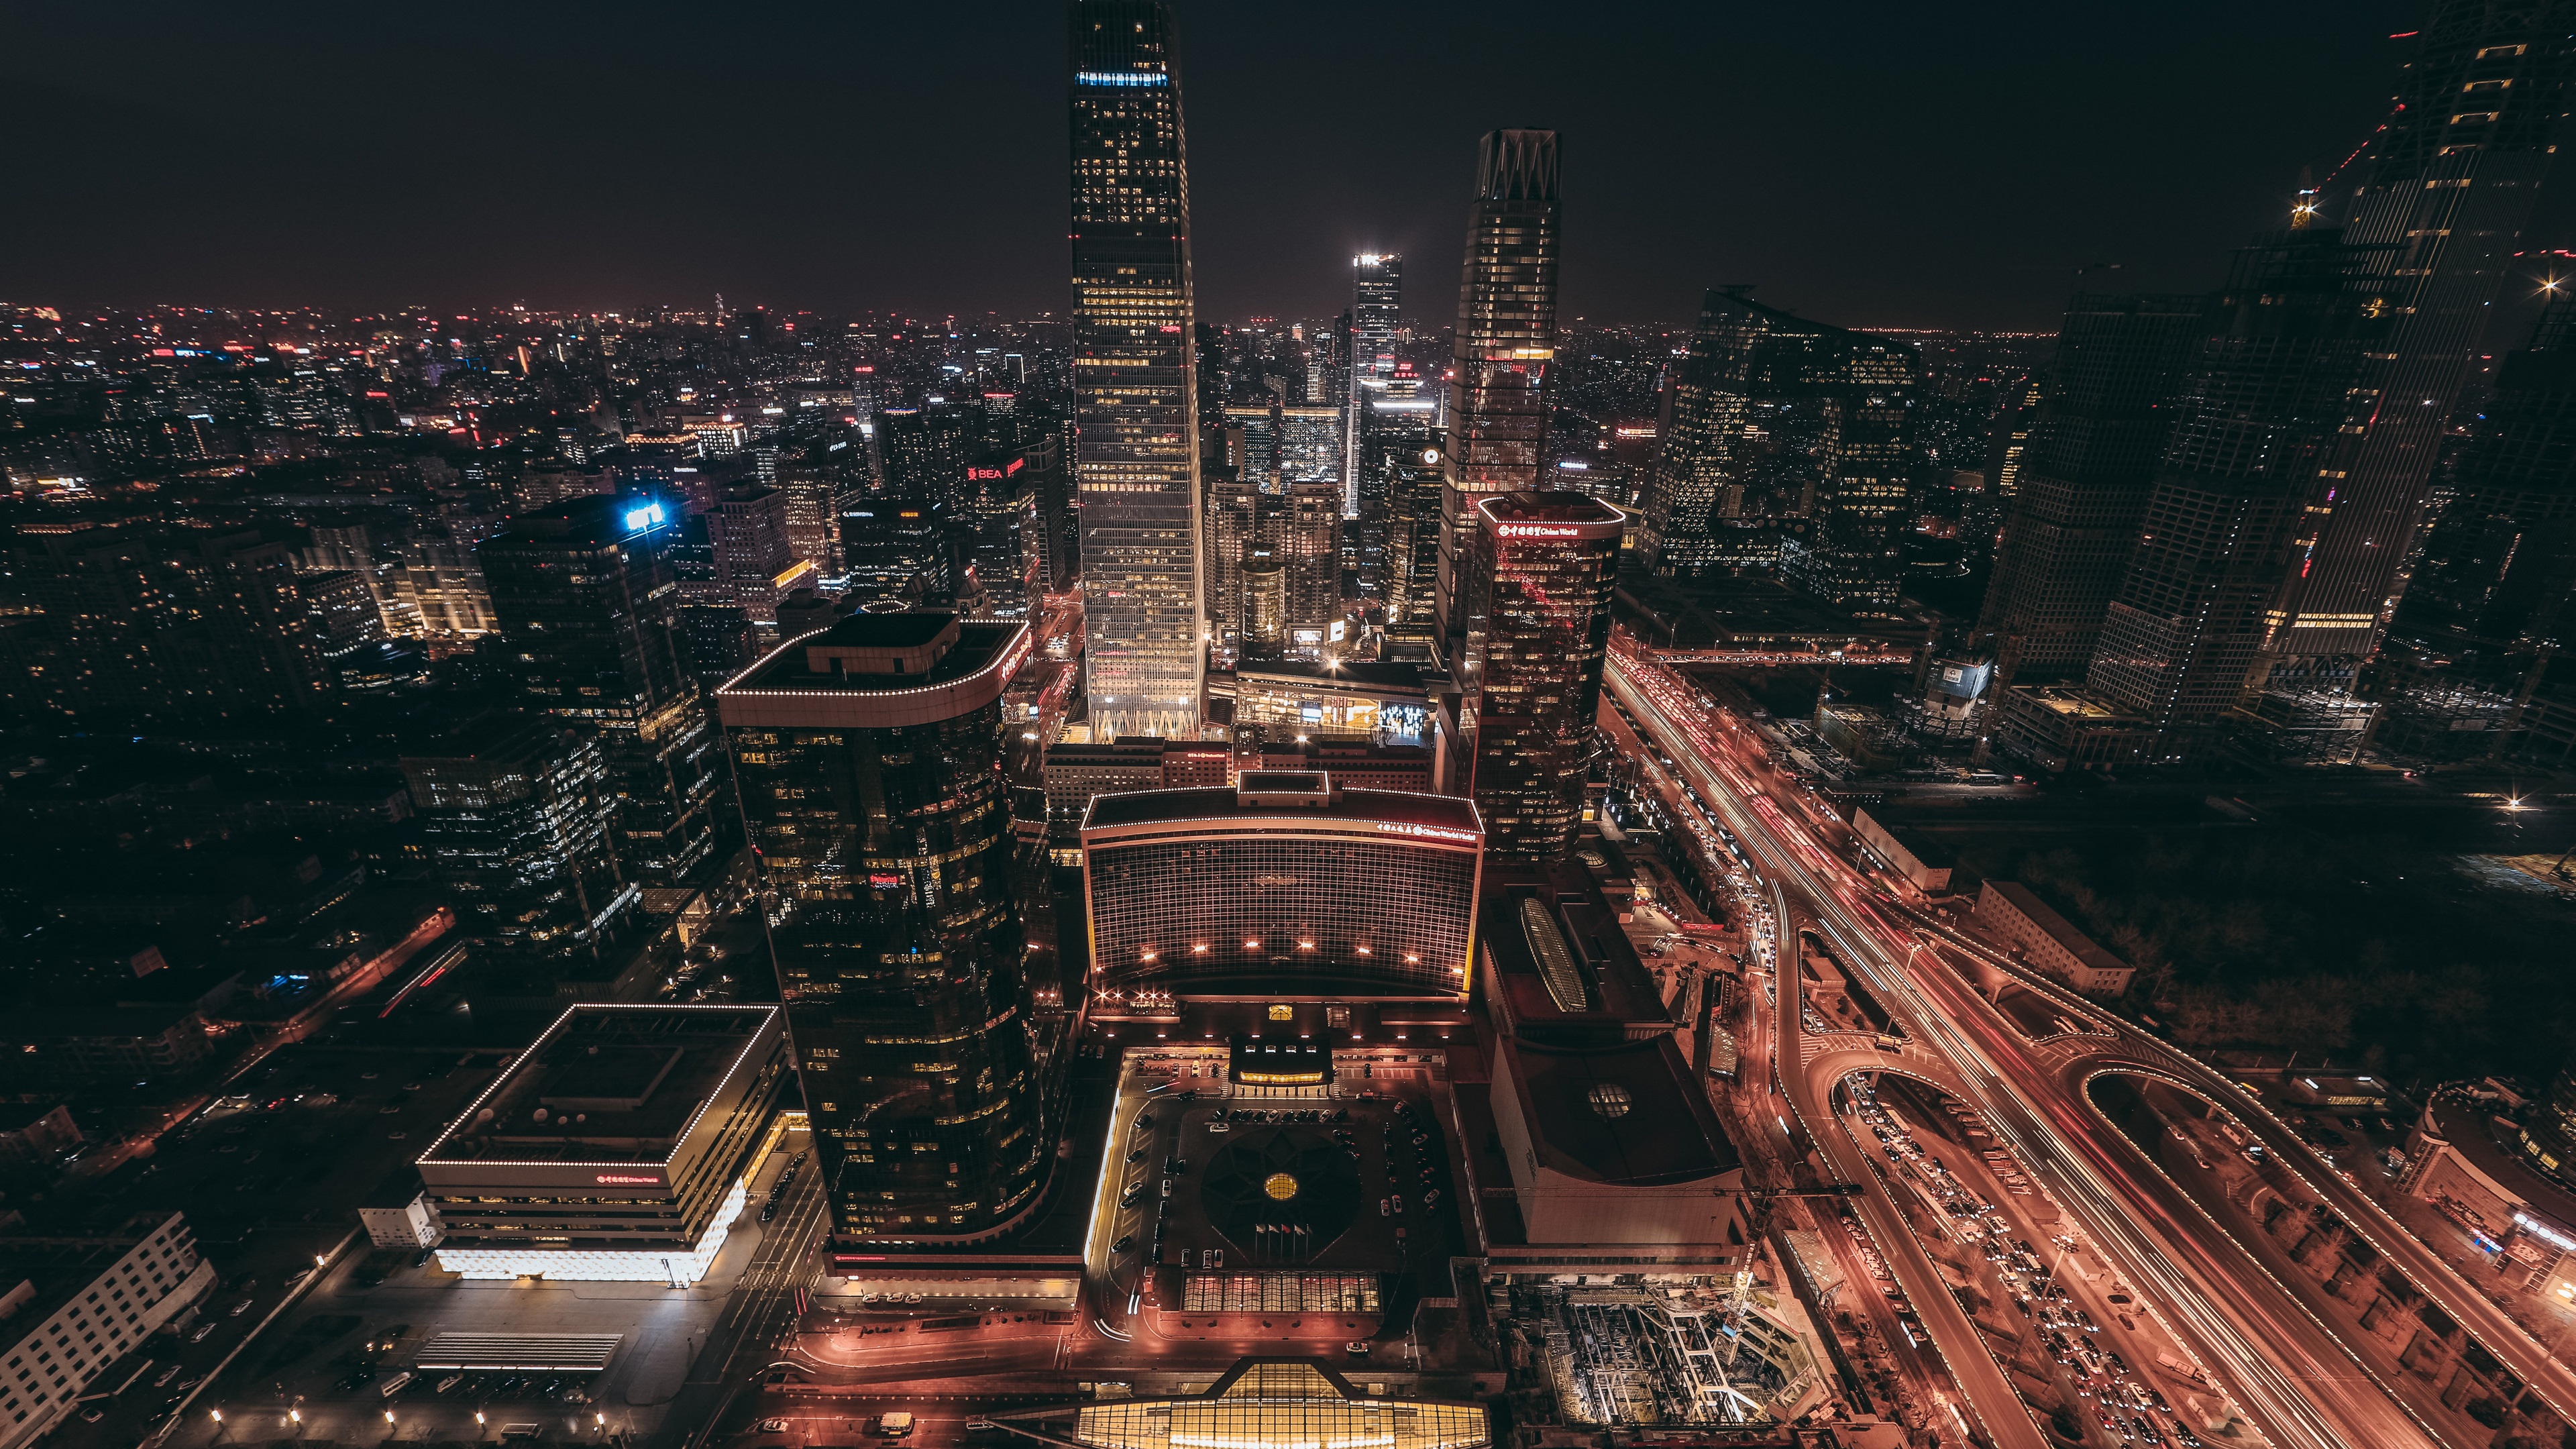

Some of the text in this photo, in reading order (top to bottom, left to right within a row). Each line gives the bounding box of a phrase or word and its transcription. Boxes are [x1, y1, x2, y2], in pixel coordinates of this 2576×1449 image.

[978, 470, 1002, 478] BEA
[1540, 527, 1559, 535] China
[1559, 528, 1578, 536] World
[1423, 828, 1440, 837] China
[1440, 830, 1459, 839] World
[1459, 833, 1476, 841] Hotel
